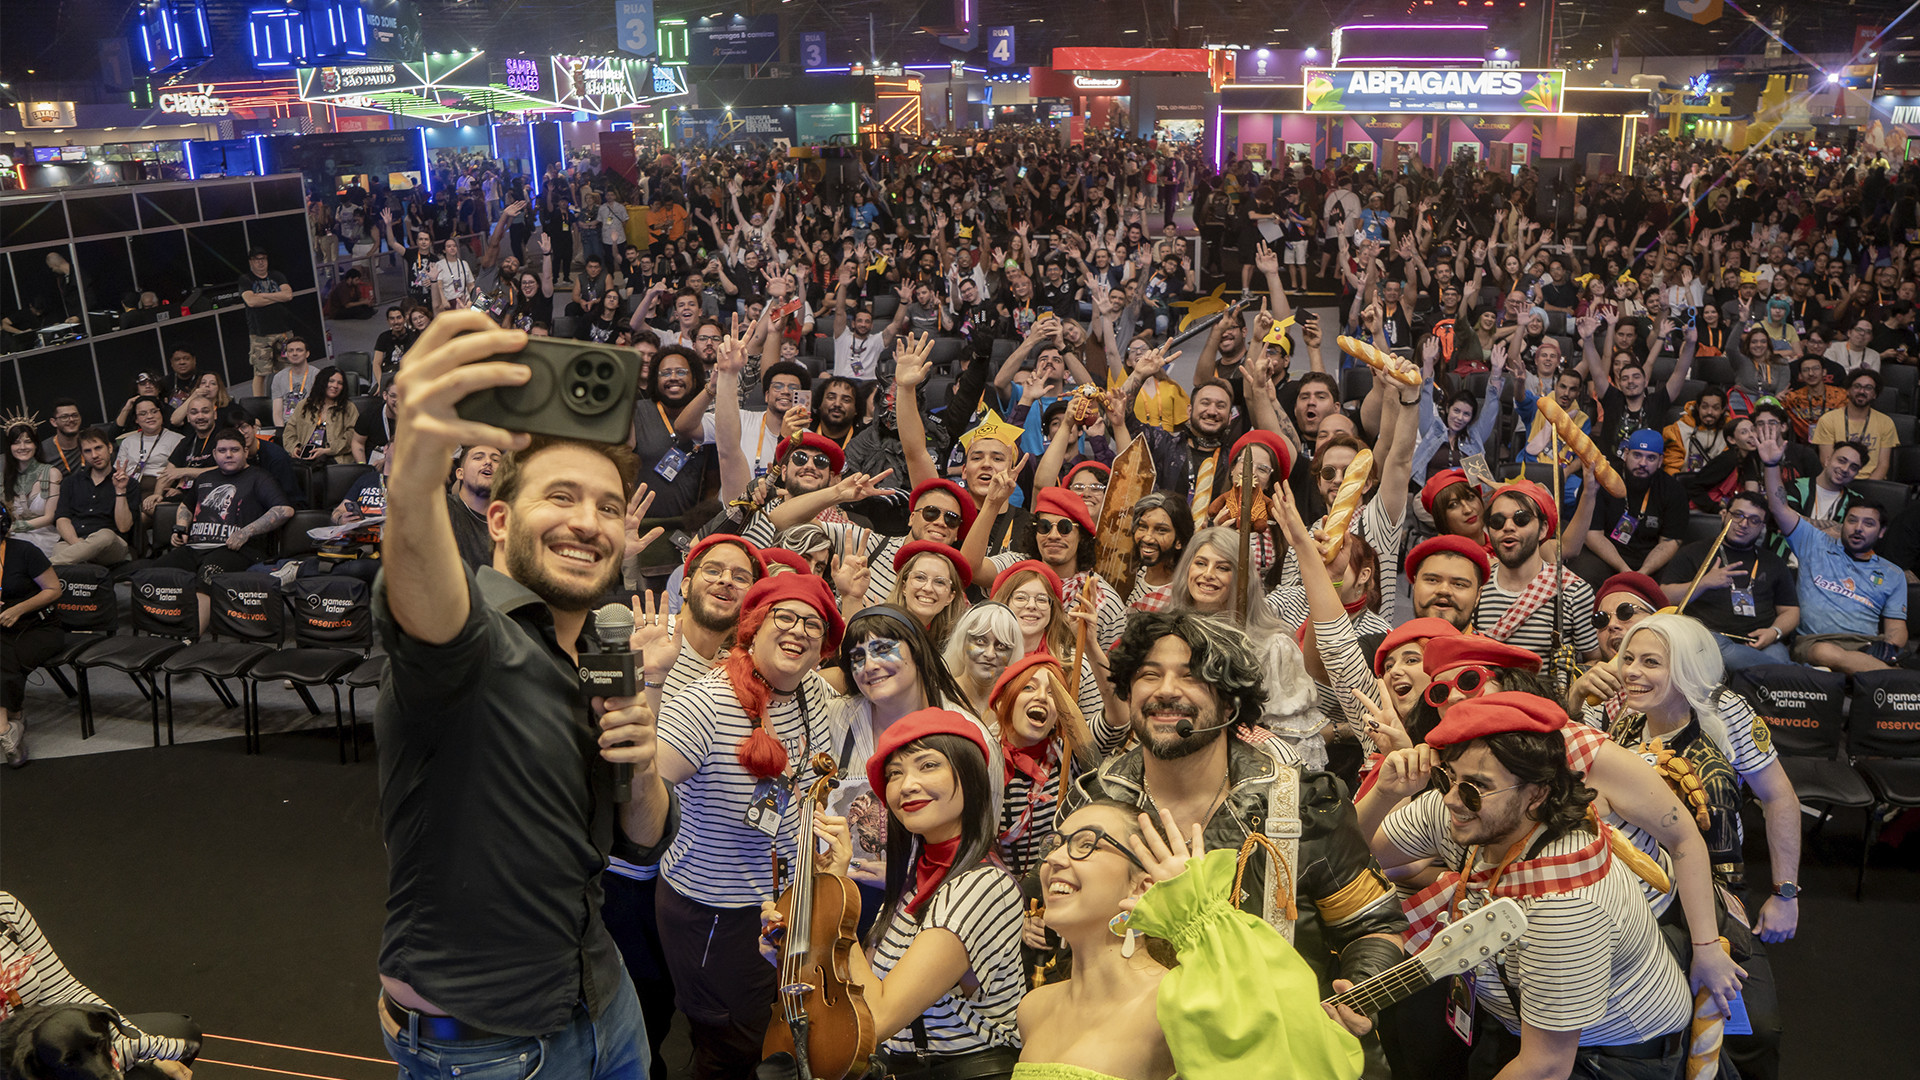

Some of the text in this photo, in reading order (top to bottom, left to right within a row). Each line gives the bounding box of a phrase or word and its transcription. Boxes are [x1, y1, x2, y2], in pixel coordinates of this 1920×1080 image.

[623, 4, 646, 14] RUA
[626, 18, 647, 50] 3
[804, 34, 821, 42] RUA
[993, 29, 1010, 37] RUA
[807, 45, 822, 66] 3
[992, 39, 1010, 61] 4
[506, 58, 538, 75] SAMPA
[364, 74, 396, 85] PAULO
[1347, 71, 1522, 95] ABRAGAMES
[1770, 689, 1828, 702] gamescom
[1775, 697, 1806, 708] latam
